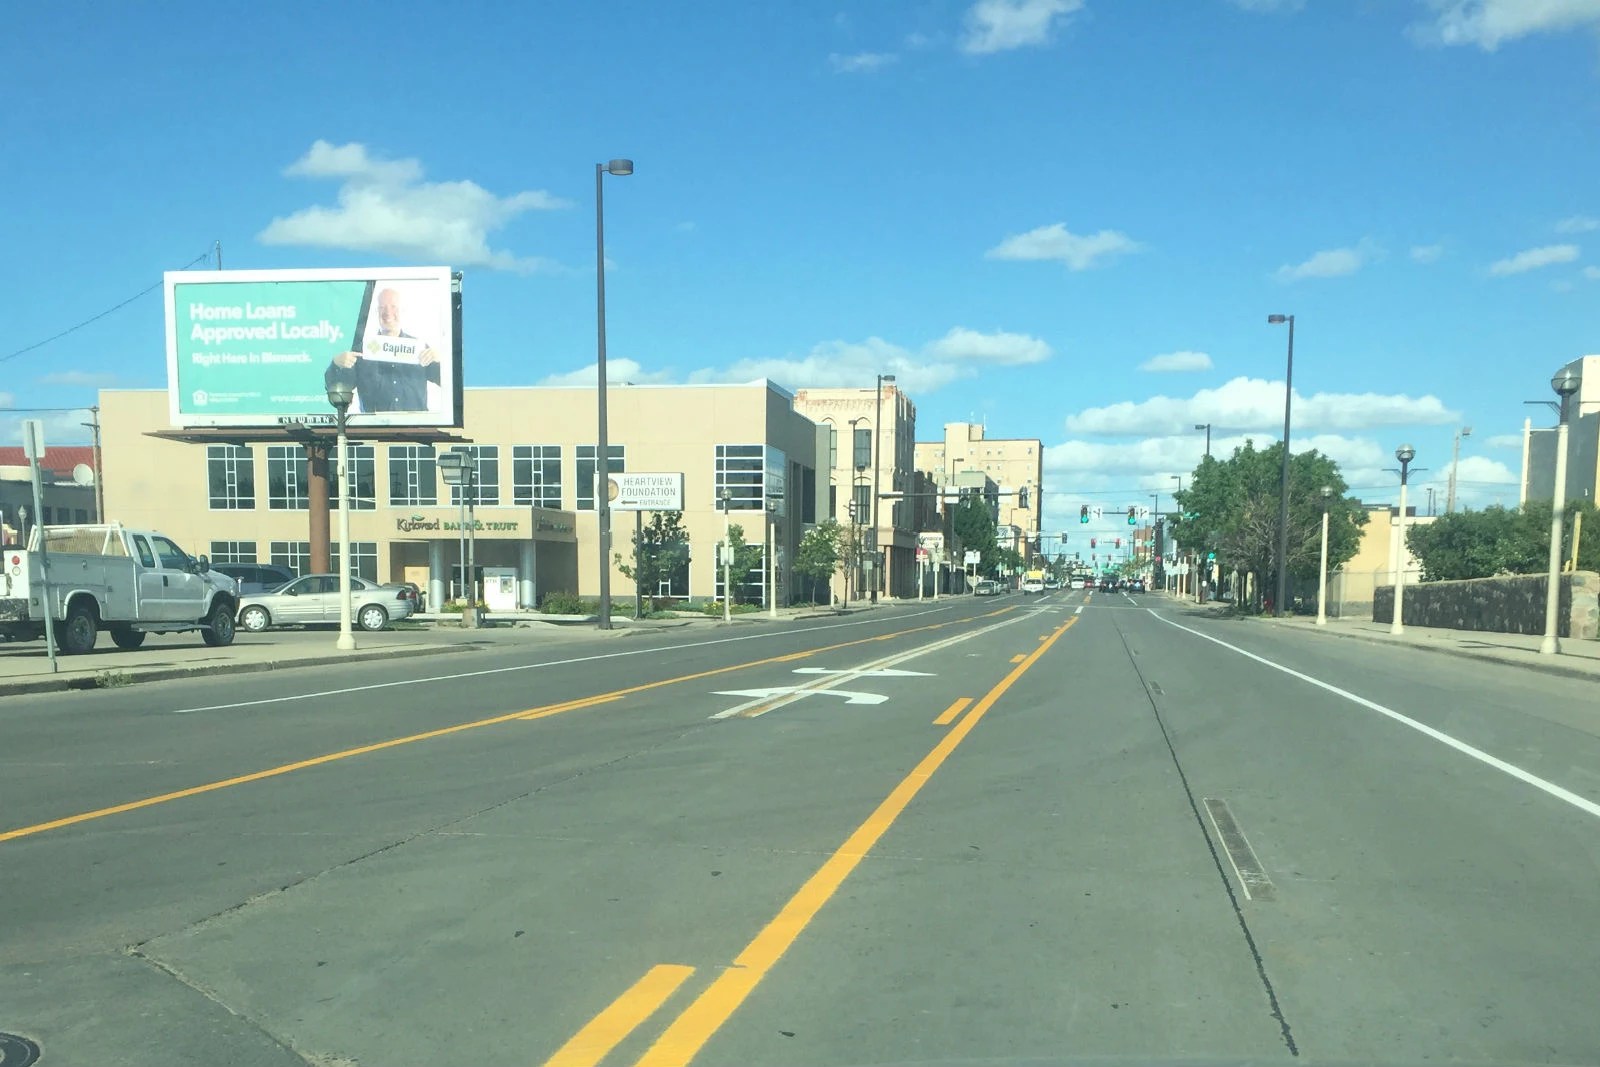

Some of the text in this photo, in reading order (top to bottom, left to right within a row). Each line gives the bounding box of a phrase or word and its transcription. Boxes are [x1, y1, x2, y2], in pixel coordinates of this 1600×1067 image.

[190, 302, 296, 320] Home Loans
[190, 319, 344, 344] Approved Locally.
[382, 342, 416, 357] Capital
[192, 352, 221, 367] Right
[222, 352, 248, 364] Here
[623, 477, 673, 487] HEARTVIEW
[621, 487, 676, 497] FOUNDATION
[474, 519, 485, 531] &
[486, 522, 519, 531] TRUST
